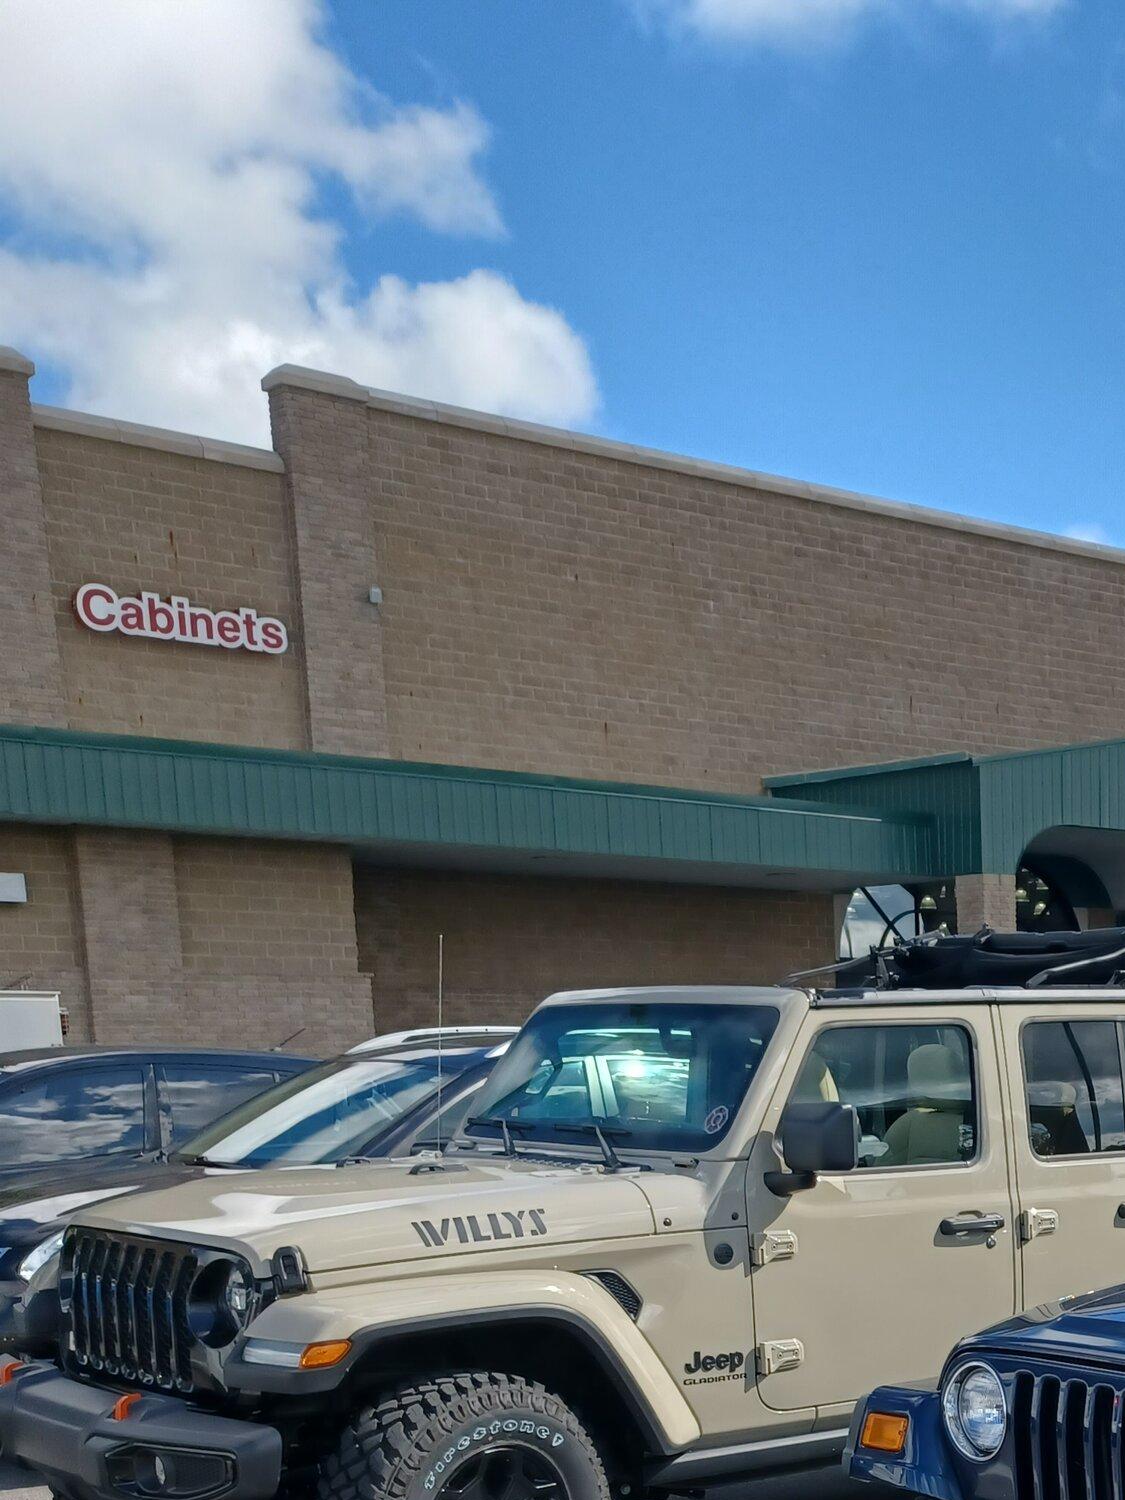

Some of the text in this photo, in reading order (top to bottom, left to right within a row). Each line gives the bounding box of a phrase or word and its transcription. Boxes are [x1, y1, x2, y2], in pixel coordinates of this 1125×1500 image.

[78, 585, 287, 652] Cabinets
[411, 1208, 548, 1247] WILLYS
[683, 1373, 748, 1386] GLADIATOR
[684, 1351, 744, 1374] Jeep
[424, 1419, 550, 1491] Firestone
